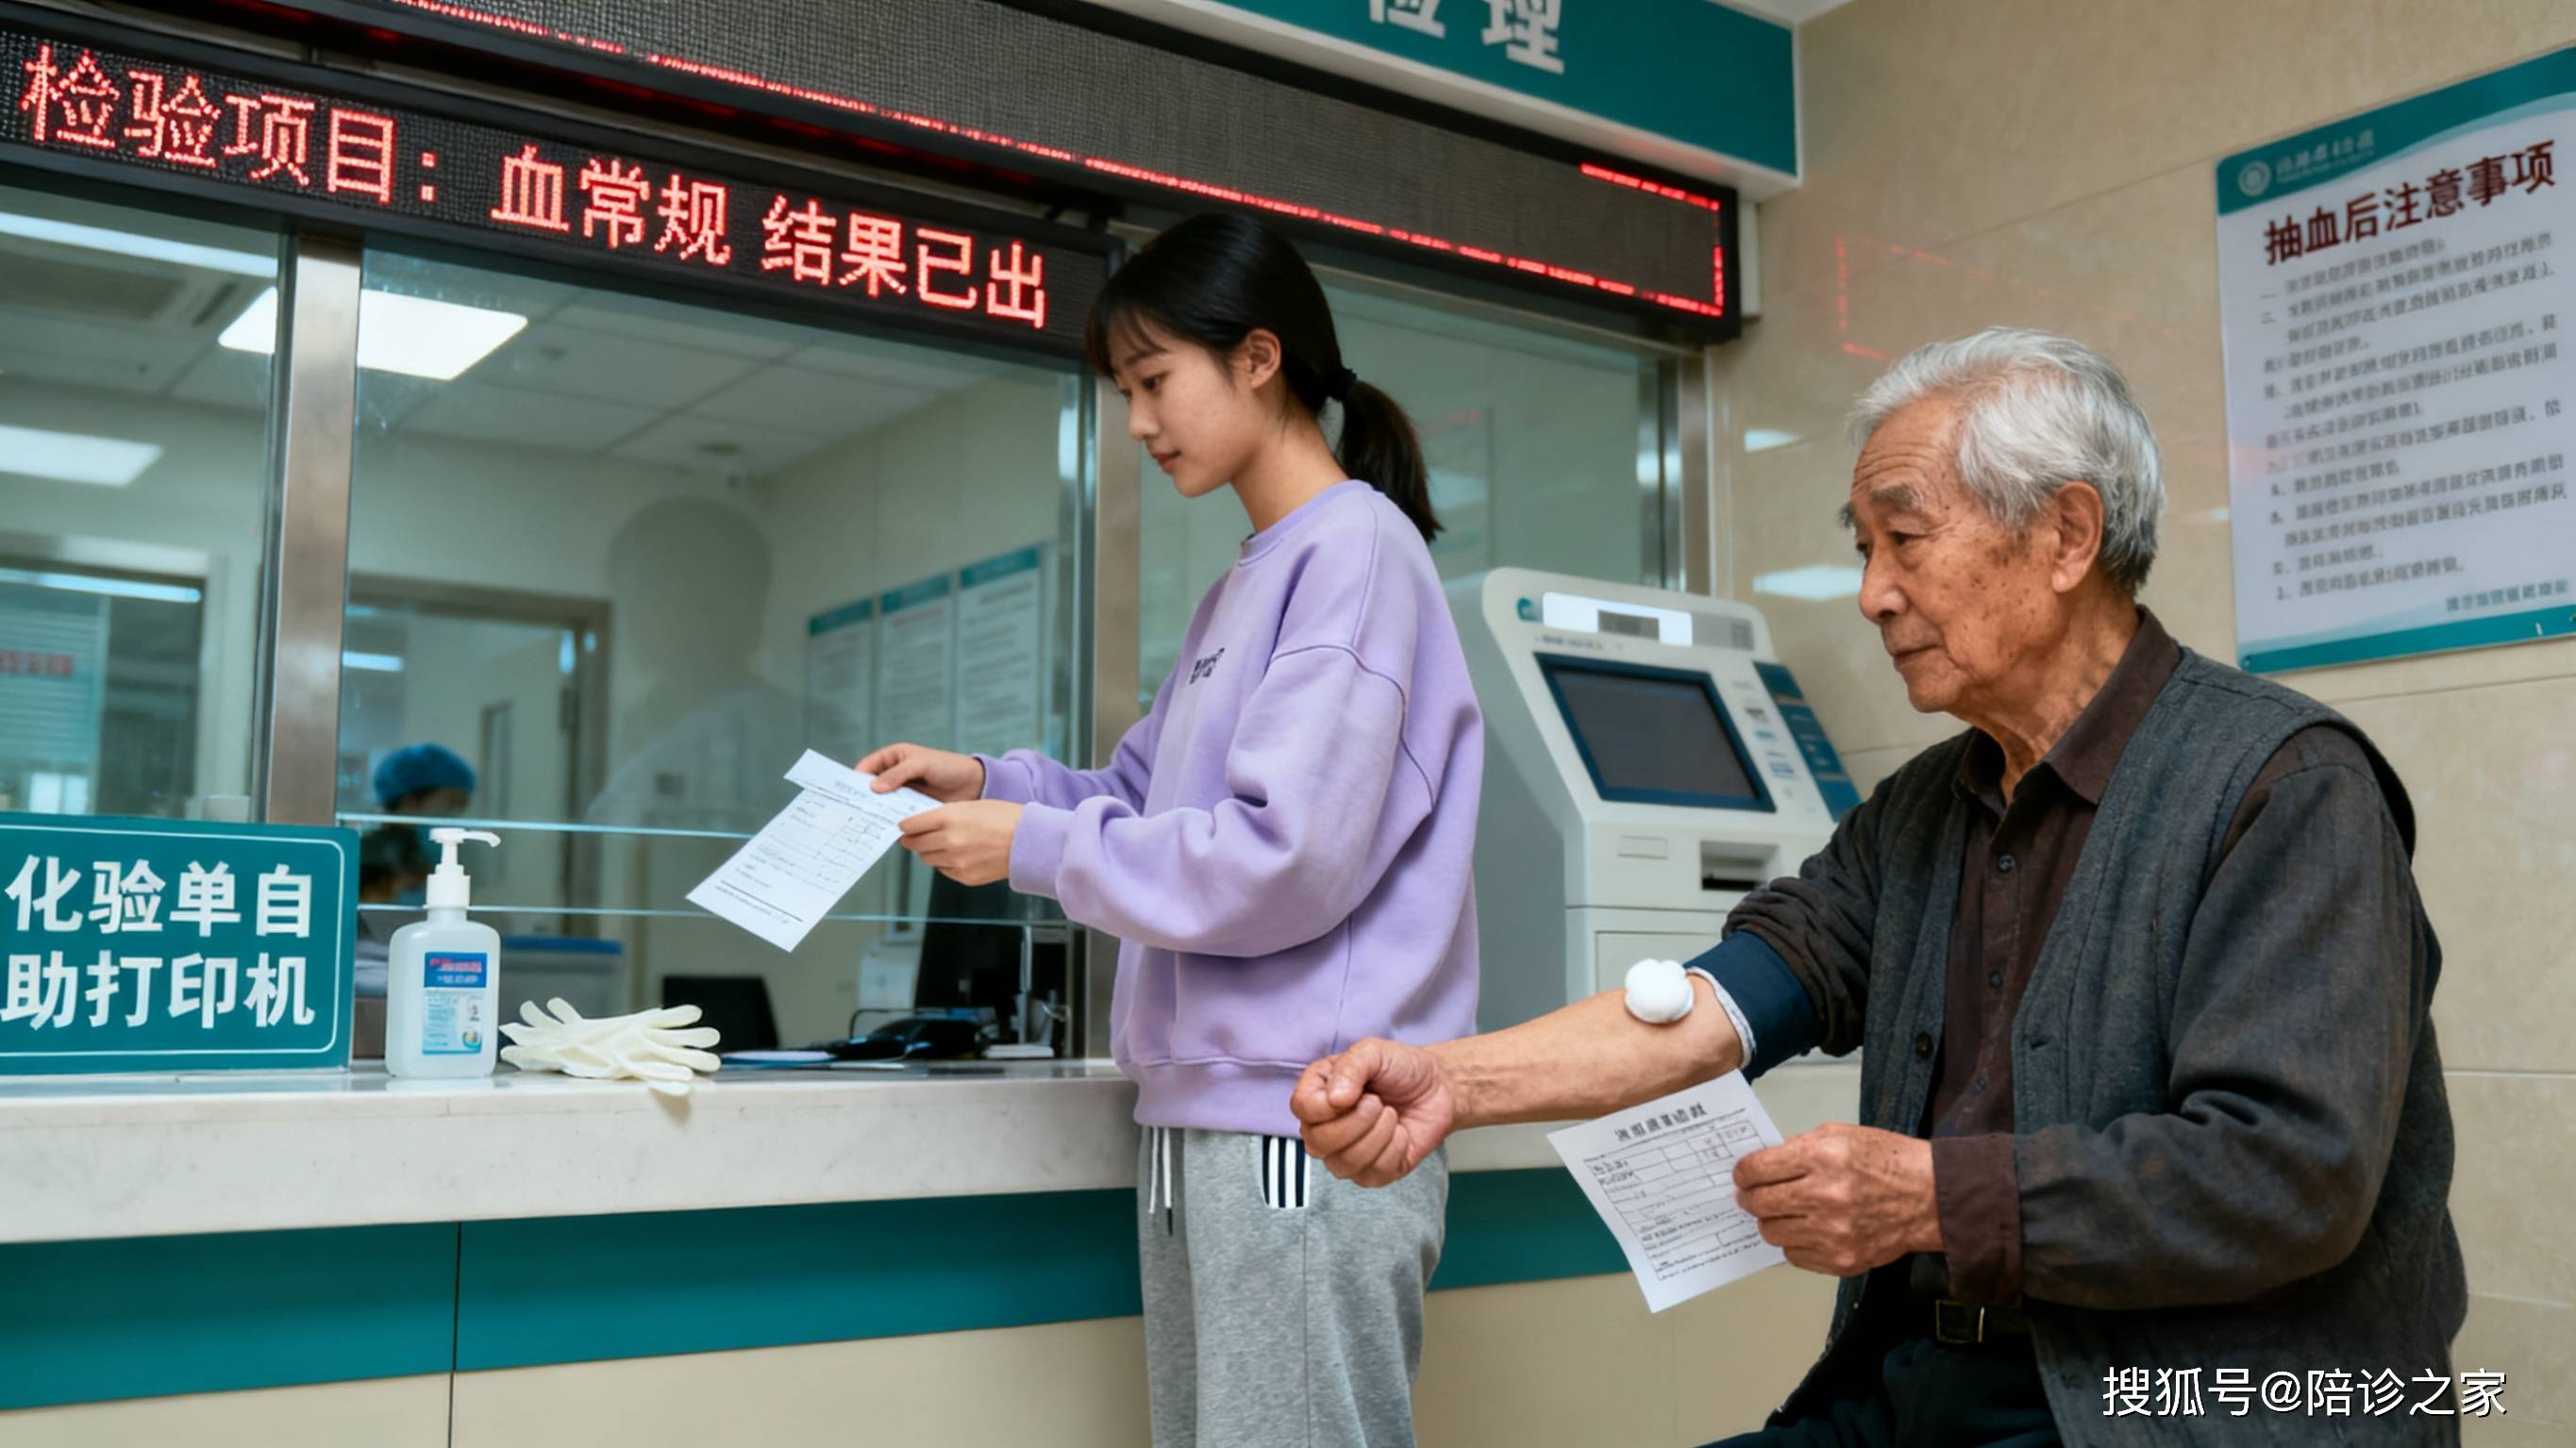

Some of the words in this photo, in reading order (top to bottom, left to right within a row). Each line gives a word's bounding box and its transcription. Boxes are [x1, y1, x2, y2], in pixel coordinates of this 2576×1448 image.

[20, 43, 437, 203] 检验项目：
[491, 144, 731, 266] 血常规
[761, 195, 1046, 328] 结果已出
[2264, 140, 2556, 265] 抽血后注意事项
[4, 854, 312, 938] 化验单自
[0, 949, 316, 1031] 助打印机
